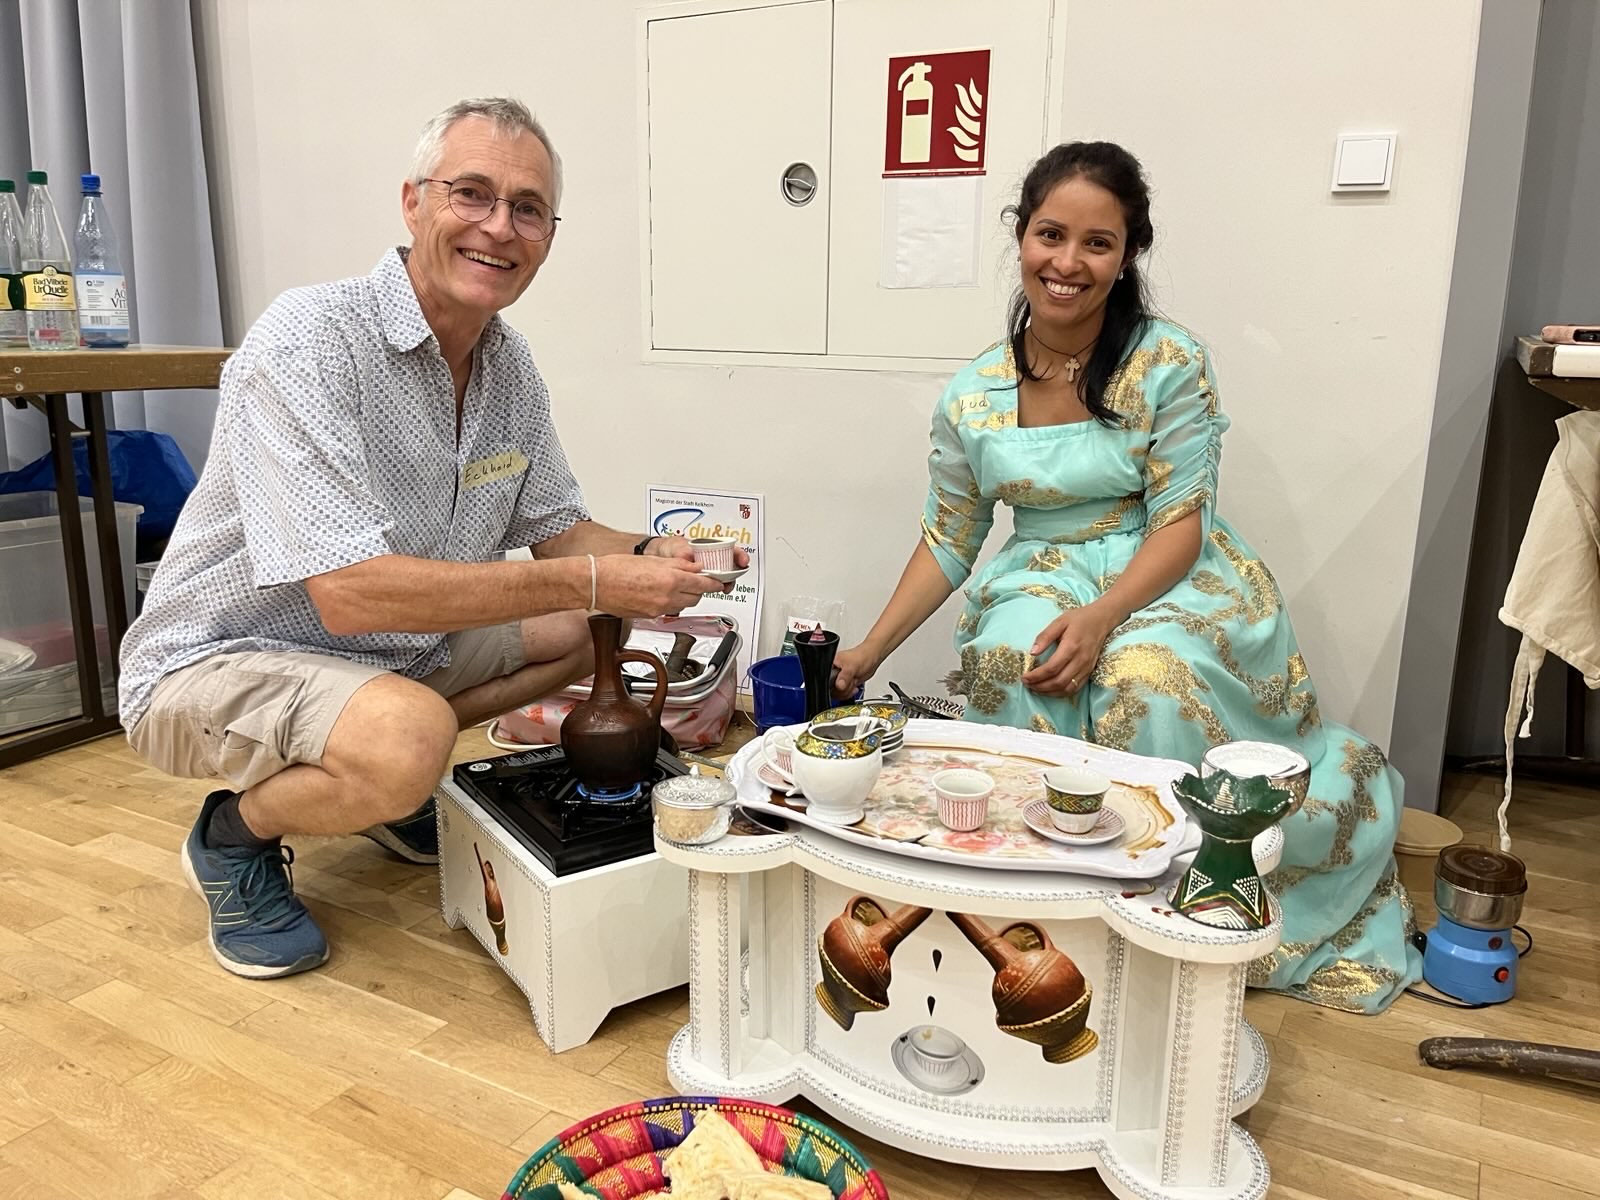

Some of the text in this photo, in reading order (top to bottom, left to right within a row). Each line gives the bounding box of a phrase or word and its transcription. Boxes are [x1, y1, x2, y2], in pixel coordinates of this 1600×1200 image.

[33, 278, 46, 286] Bad
[736, 584, 756, 593] leben
[735, 595, 747, 603] e.V.
